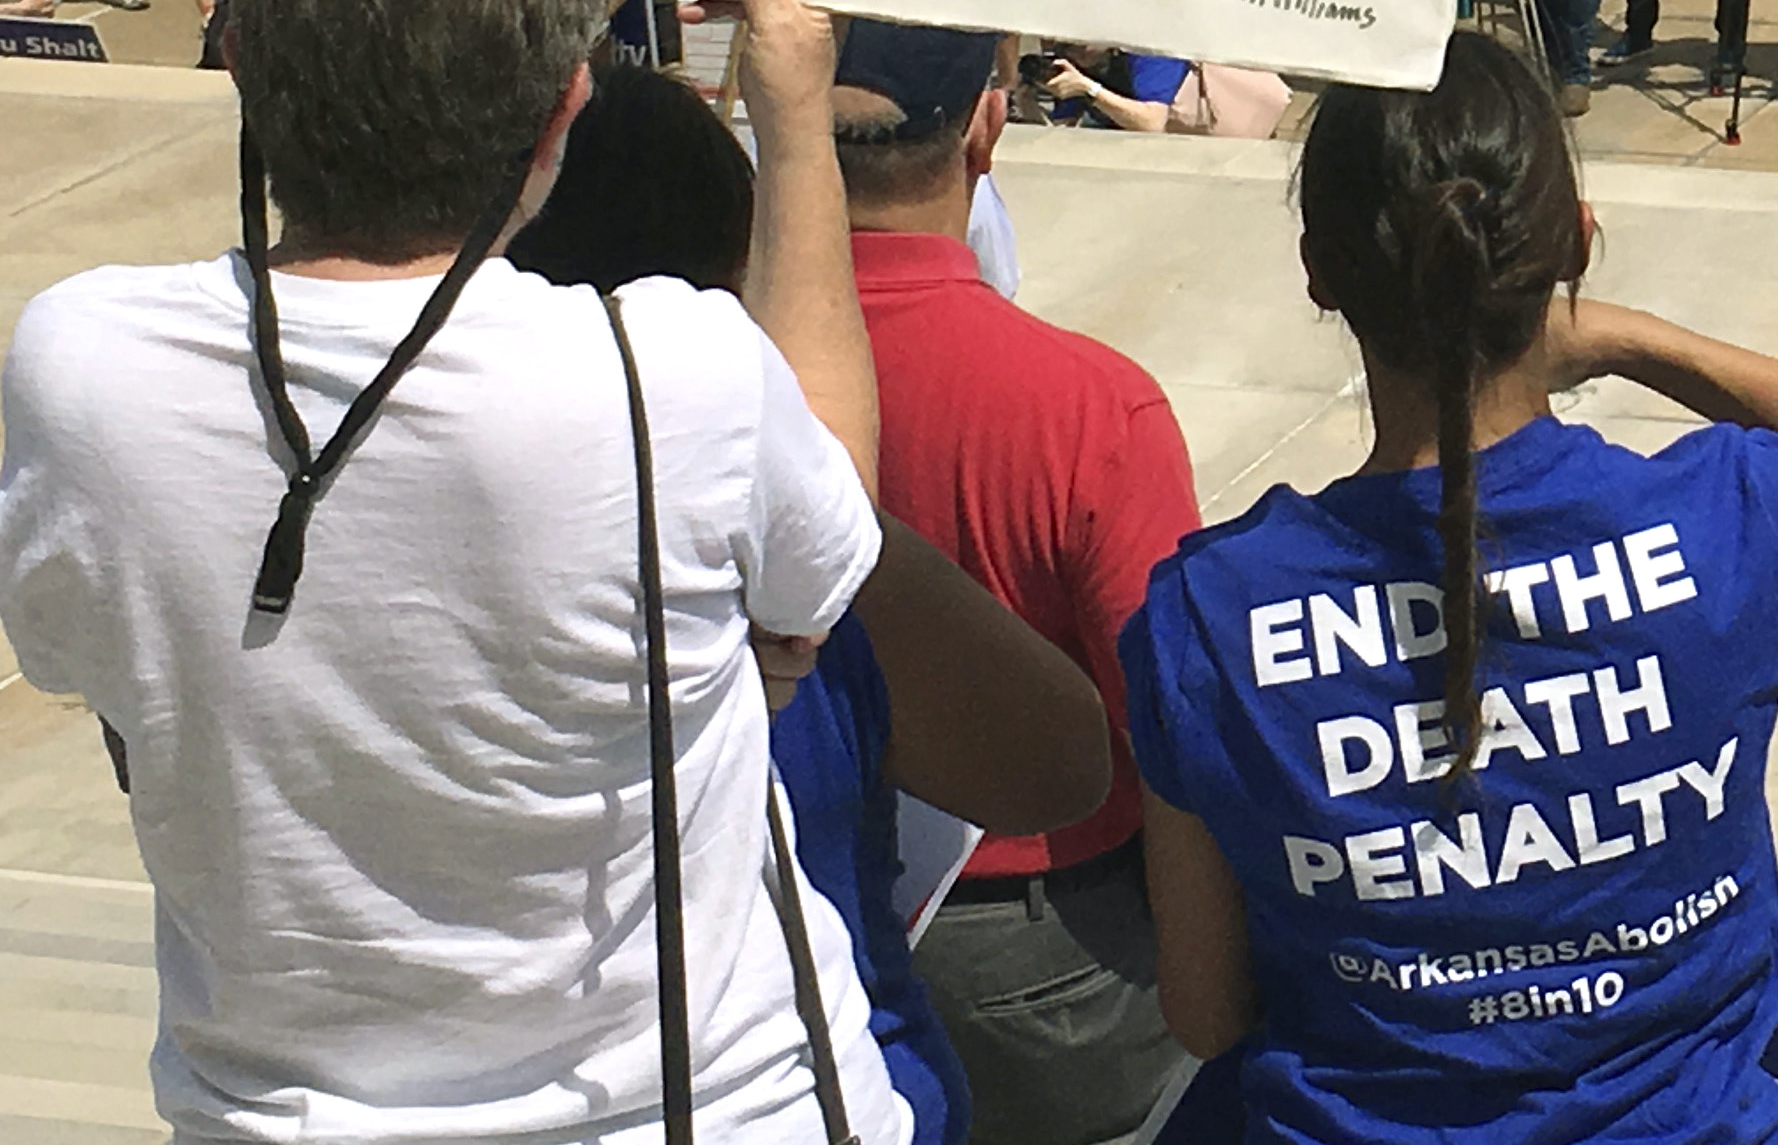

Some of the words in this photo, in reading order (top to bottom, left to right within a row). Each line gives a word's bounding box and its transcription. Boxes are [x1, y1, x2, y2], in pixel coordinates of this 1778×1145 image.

[25, 36, 101, 58] Shalt
[1249, 582, 1449, 688] END
[1485, 524, 1697, 640] THE
[1316, 655, 1674, 798] DEATH
[1282, 736, 1739, 901] PENALTY
[1330, 873, 1740, 993] @ArkansasAbolish
[1468, 970, 1624, 1026] #8in10
